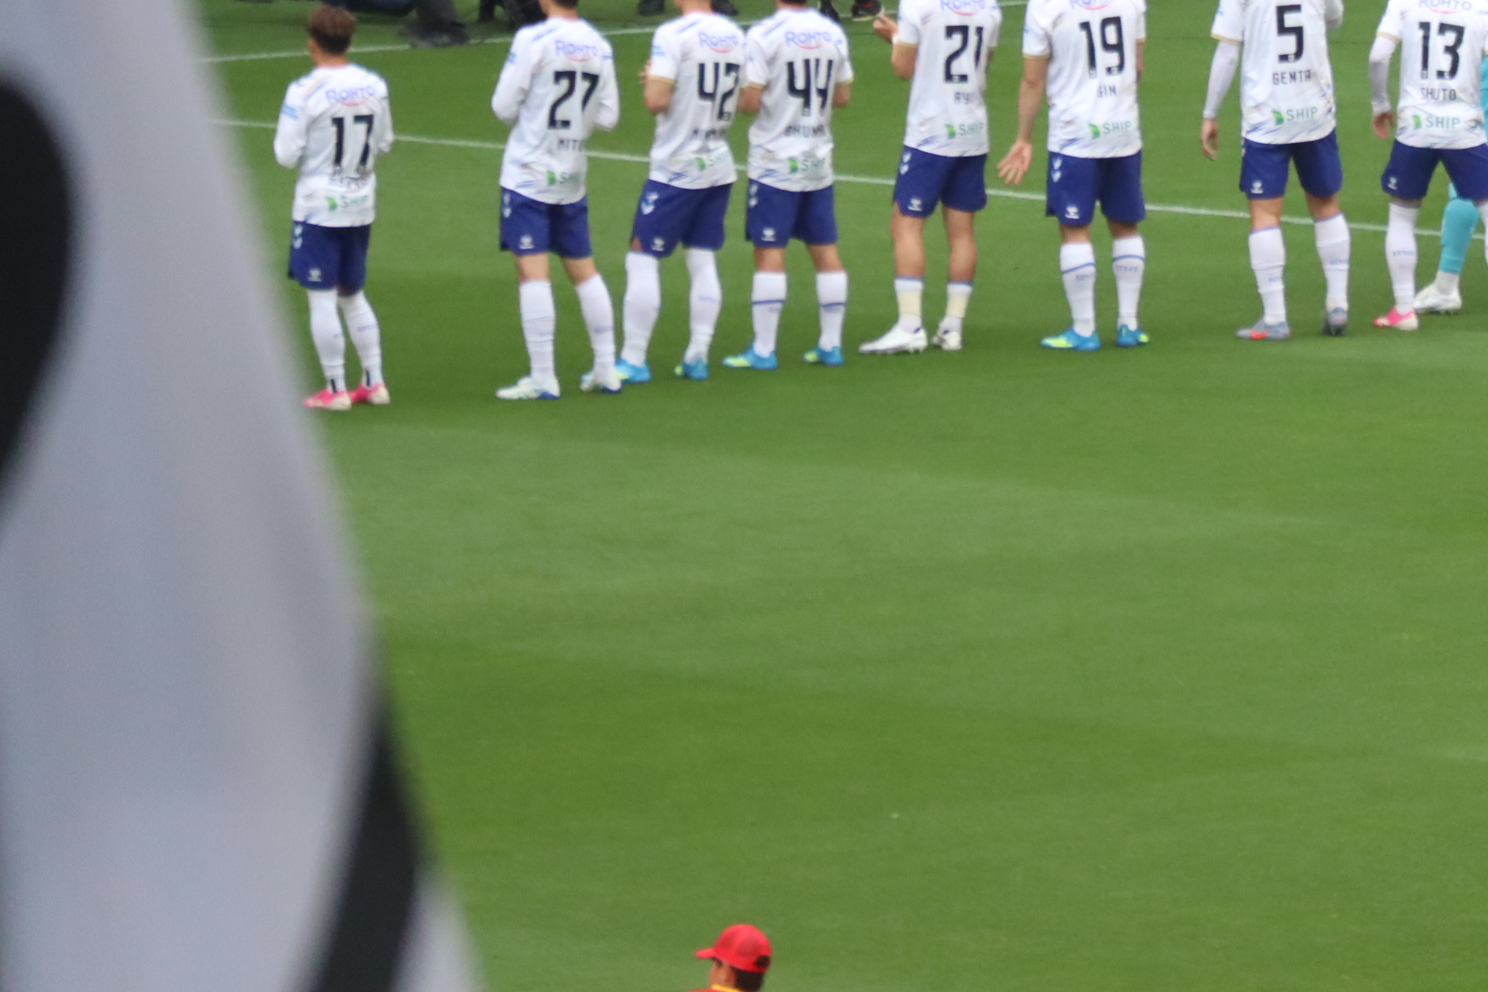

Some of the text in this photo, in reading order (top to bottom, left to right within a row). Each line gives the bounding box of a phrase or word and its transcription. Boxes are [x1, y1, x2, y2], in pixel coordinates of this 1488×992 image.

[944, 25, 984, 83] 21
[1079, 16, 1124, 79] 19
[1275, 4, 1304, 64] 5
[1418, 21, 1465, 80] 13
[548, 70, 599, 130] 27
[697, 61, 740, 123] 42
[786, 58, 833, 118] 44
[1272, 70, 1312, 85] GENTA
[1420, 88, 1456, 102] SHUTO
[1102, 120, 1131, 135] SHIP
[1286, 107, 1318, 122] SHIP
[1425, 116, 1460, 130] SHIP
[331, 113, 375, 178] 17
